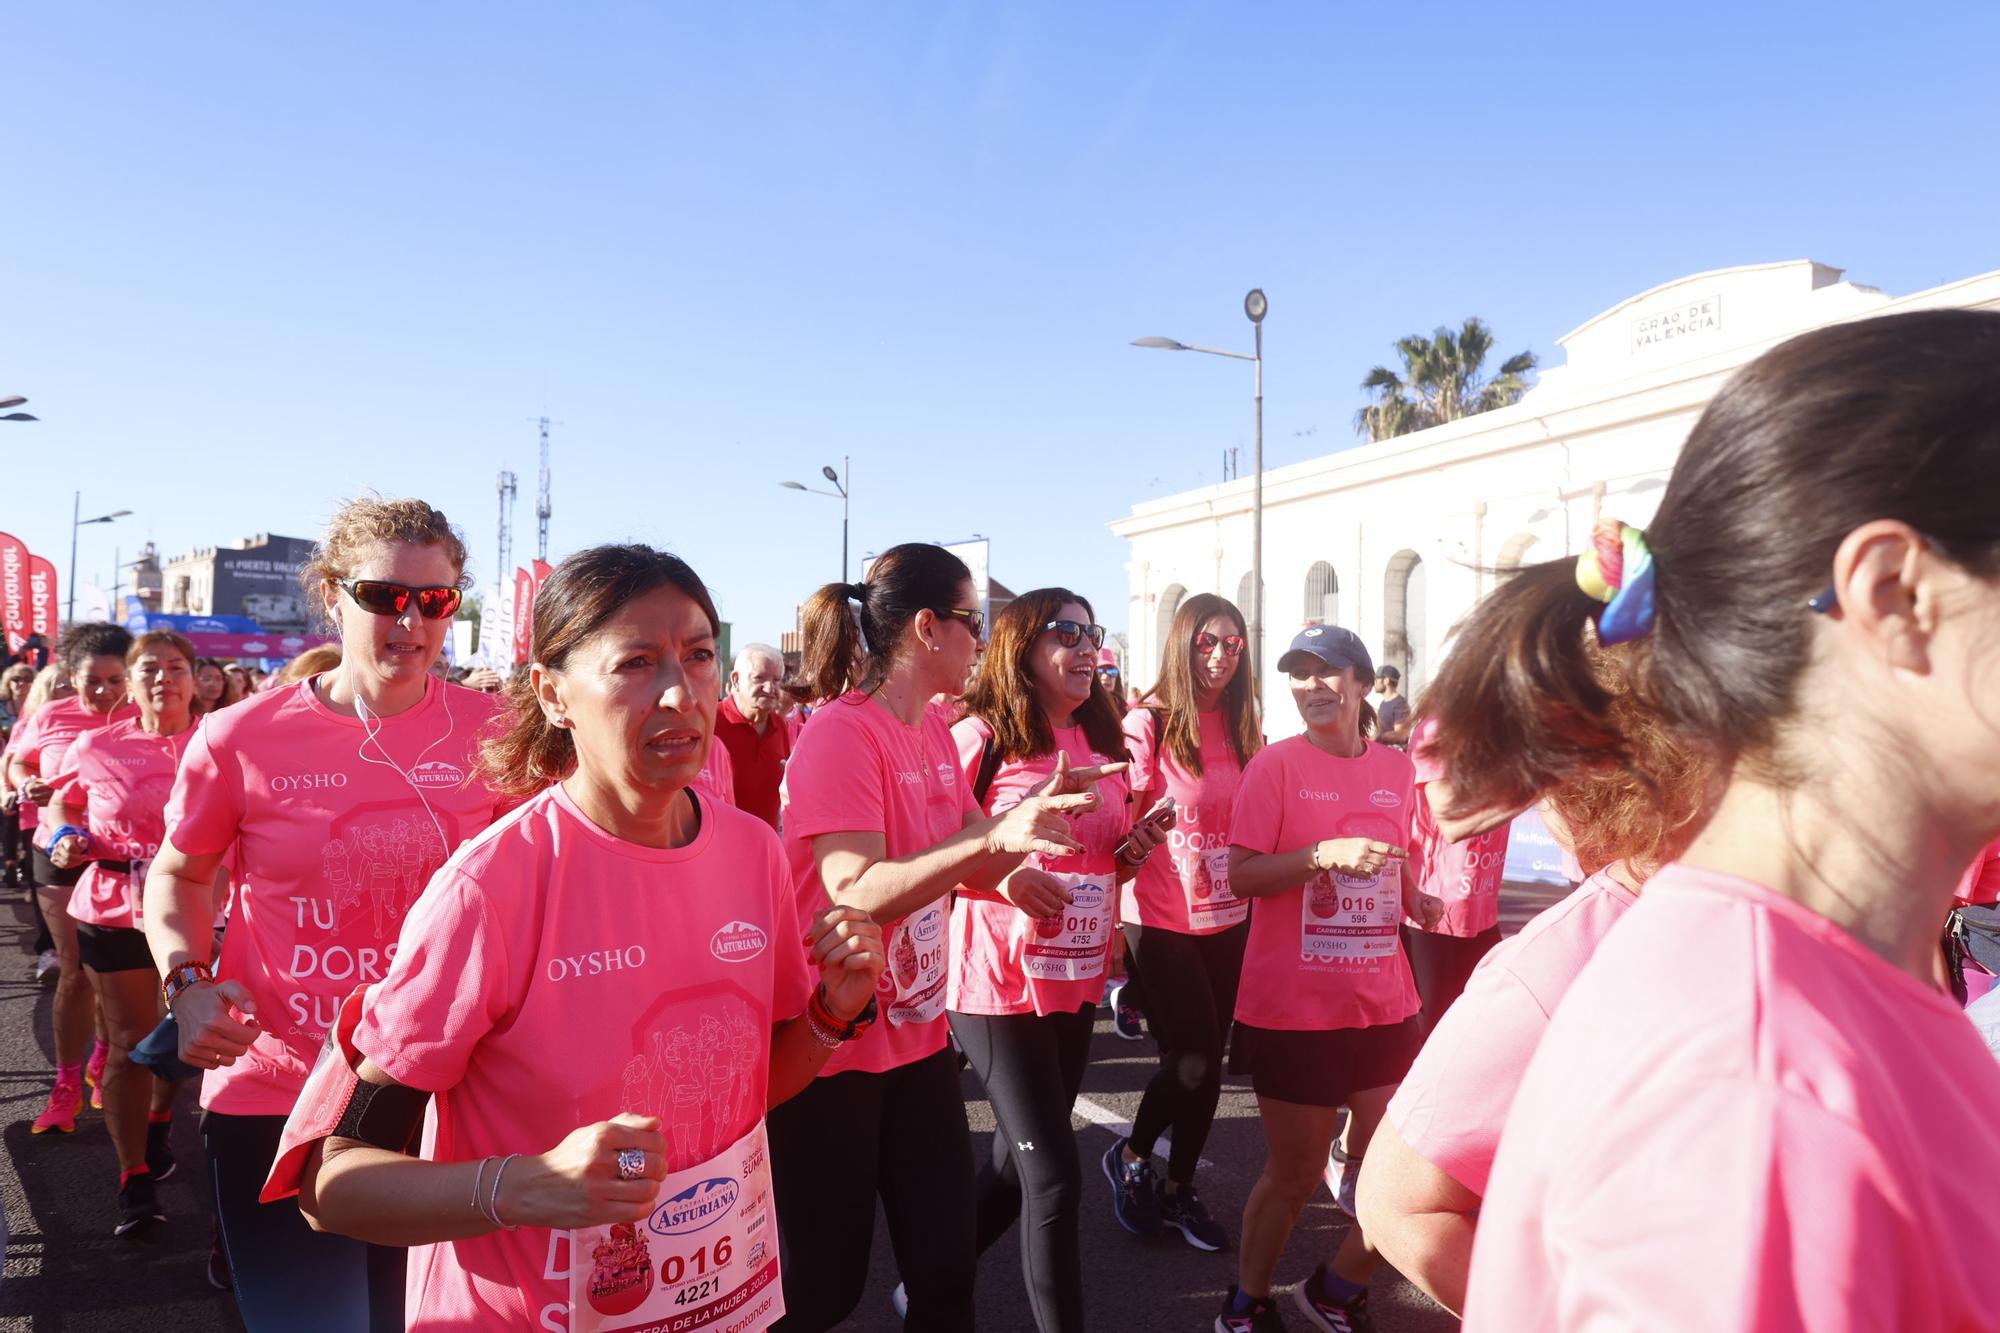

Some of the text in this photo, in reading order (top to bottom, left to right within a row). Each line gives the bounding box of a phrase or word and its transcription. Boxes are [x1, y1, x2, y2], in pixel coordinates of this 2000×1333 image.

[1640, 302, 1711, 333] GRAO DE
[1636, 316, 1714, 347] VALENCIA
[3, 545, 23, 630] Santander
[30, 571, 49, 634] ander
[271, 772, 348, 792] OYSHO
[411, 772, 461, 784] ASTURIANA
[1299, 788, 1340, 801] OYSHO
[1173, 805, 1199, 824] TU
[1171, 829, 1226, 851] DORS
[1169, 855, 1190, 877] SU
[1214, 879, 1229, 891] 01
[289, 896, 335, 930] TU
[1342, 897, 1375, 911] 016
[1066, 917, 1098, 932] 016
[1351, 914, 1367, 923] 596
[716, 937, 763, 955] ASTURIANA
[1071, 935, 1092, 945] 4752
[1312, 940, 1347, 950] OYSHO
[547, 945, 647, 982] OYSHO
[920, 944, 942, 970] 016
[1031, 961, 1067, 973] OYSHO
[288, 992, 340, 1029] SU
[743, 1152, 764, 1179] SUMA
[657, 1189, 735, 1230] ASTURIANA
[660, 1235, 733, 1285] 016
[673, 1316, 691, 1331] DE
[695, 1312, 710, 1325] LA
[713, 1288, 748, 1317] MUJER
[750, 1270, 769, 1294] 2023
[674, 1276, 720, 1306] 4221
[725, 1296, 772, 1333] Santander
